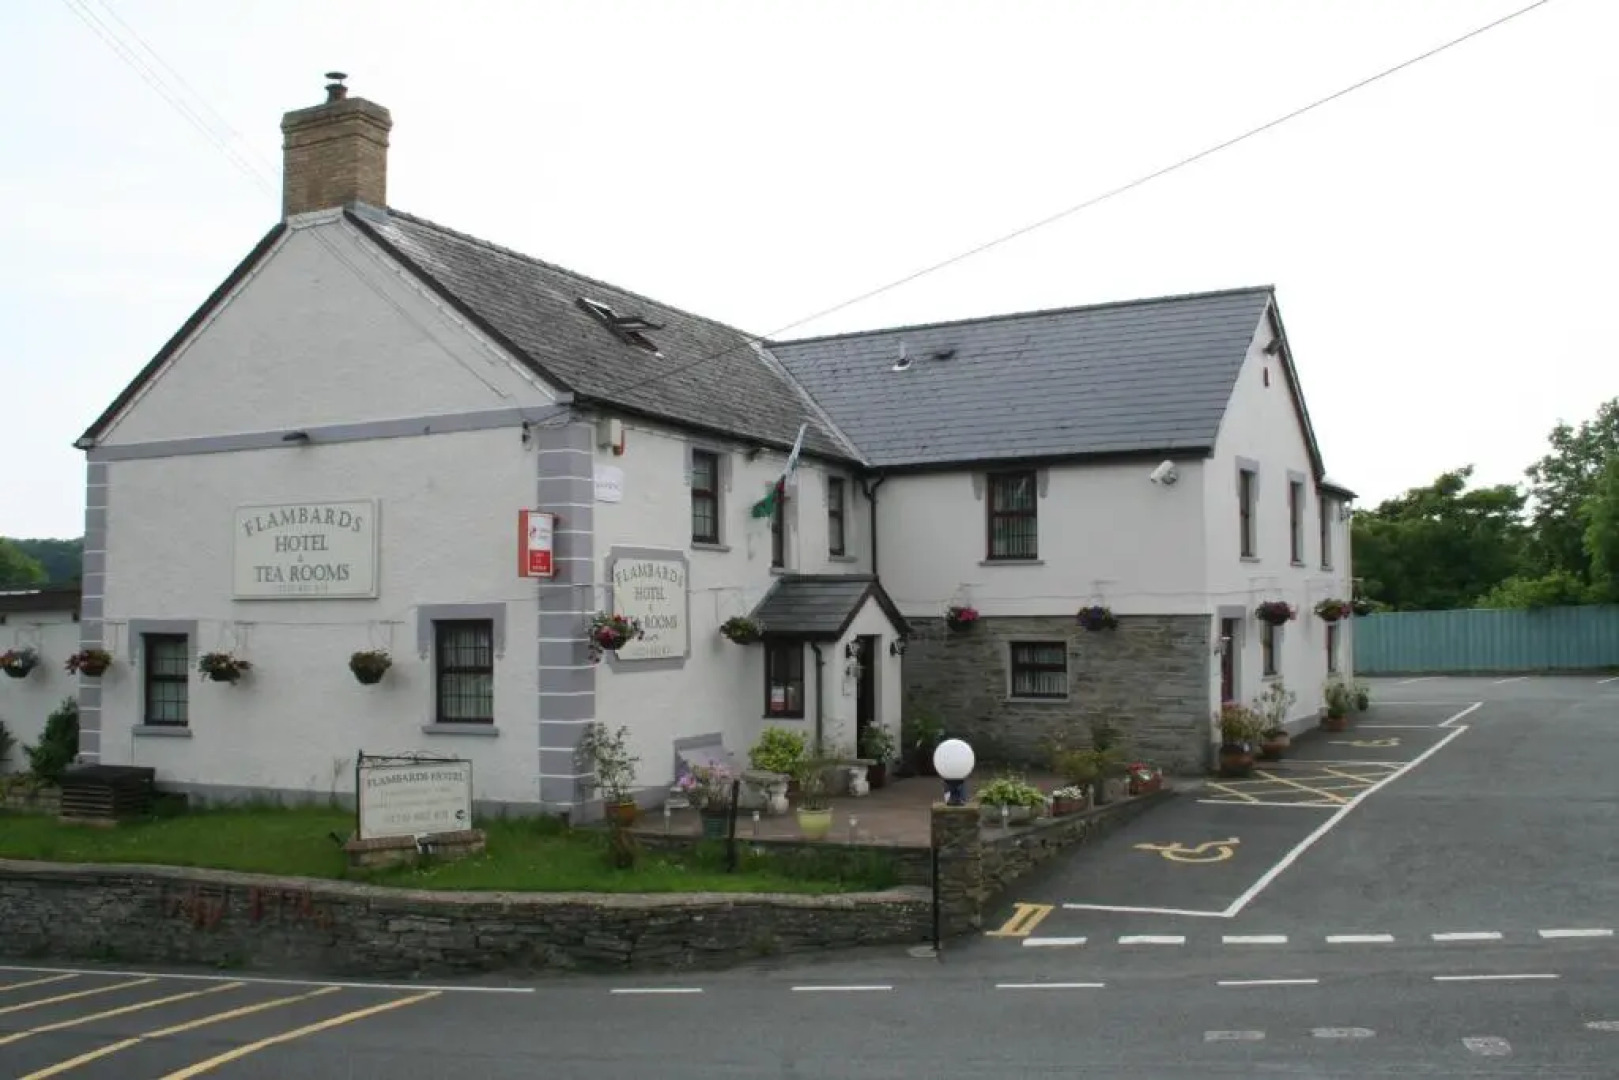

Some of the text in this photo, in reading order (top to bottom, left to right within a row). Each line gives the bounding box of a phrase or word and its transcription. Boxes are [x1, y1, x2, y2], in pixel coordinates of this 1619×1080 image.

[244, 507, 363, 537] FLAMBARDS
[275, 534, 329, 552] HOTEL
[253, 563, 350, 583] TEA ROOMS
[615, 563, 684, 589] FLAMBARDS
[633, 586, 666, 601] HOTEL
[366, 771, 428, 788] FLAMBARDS
